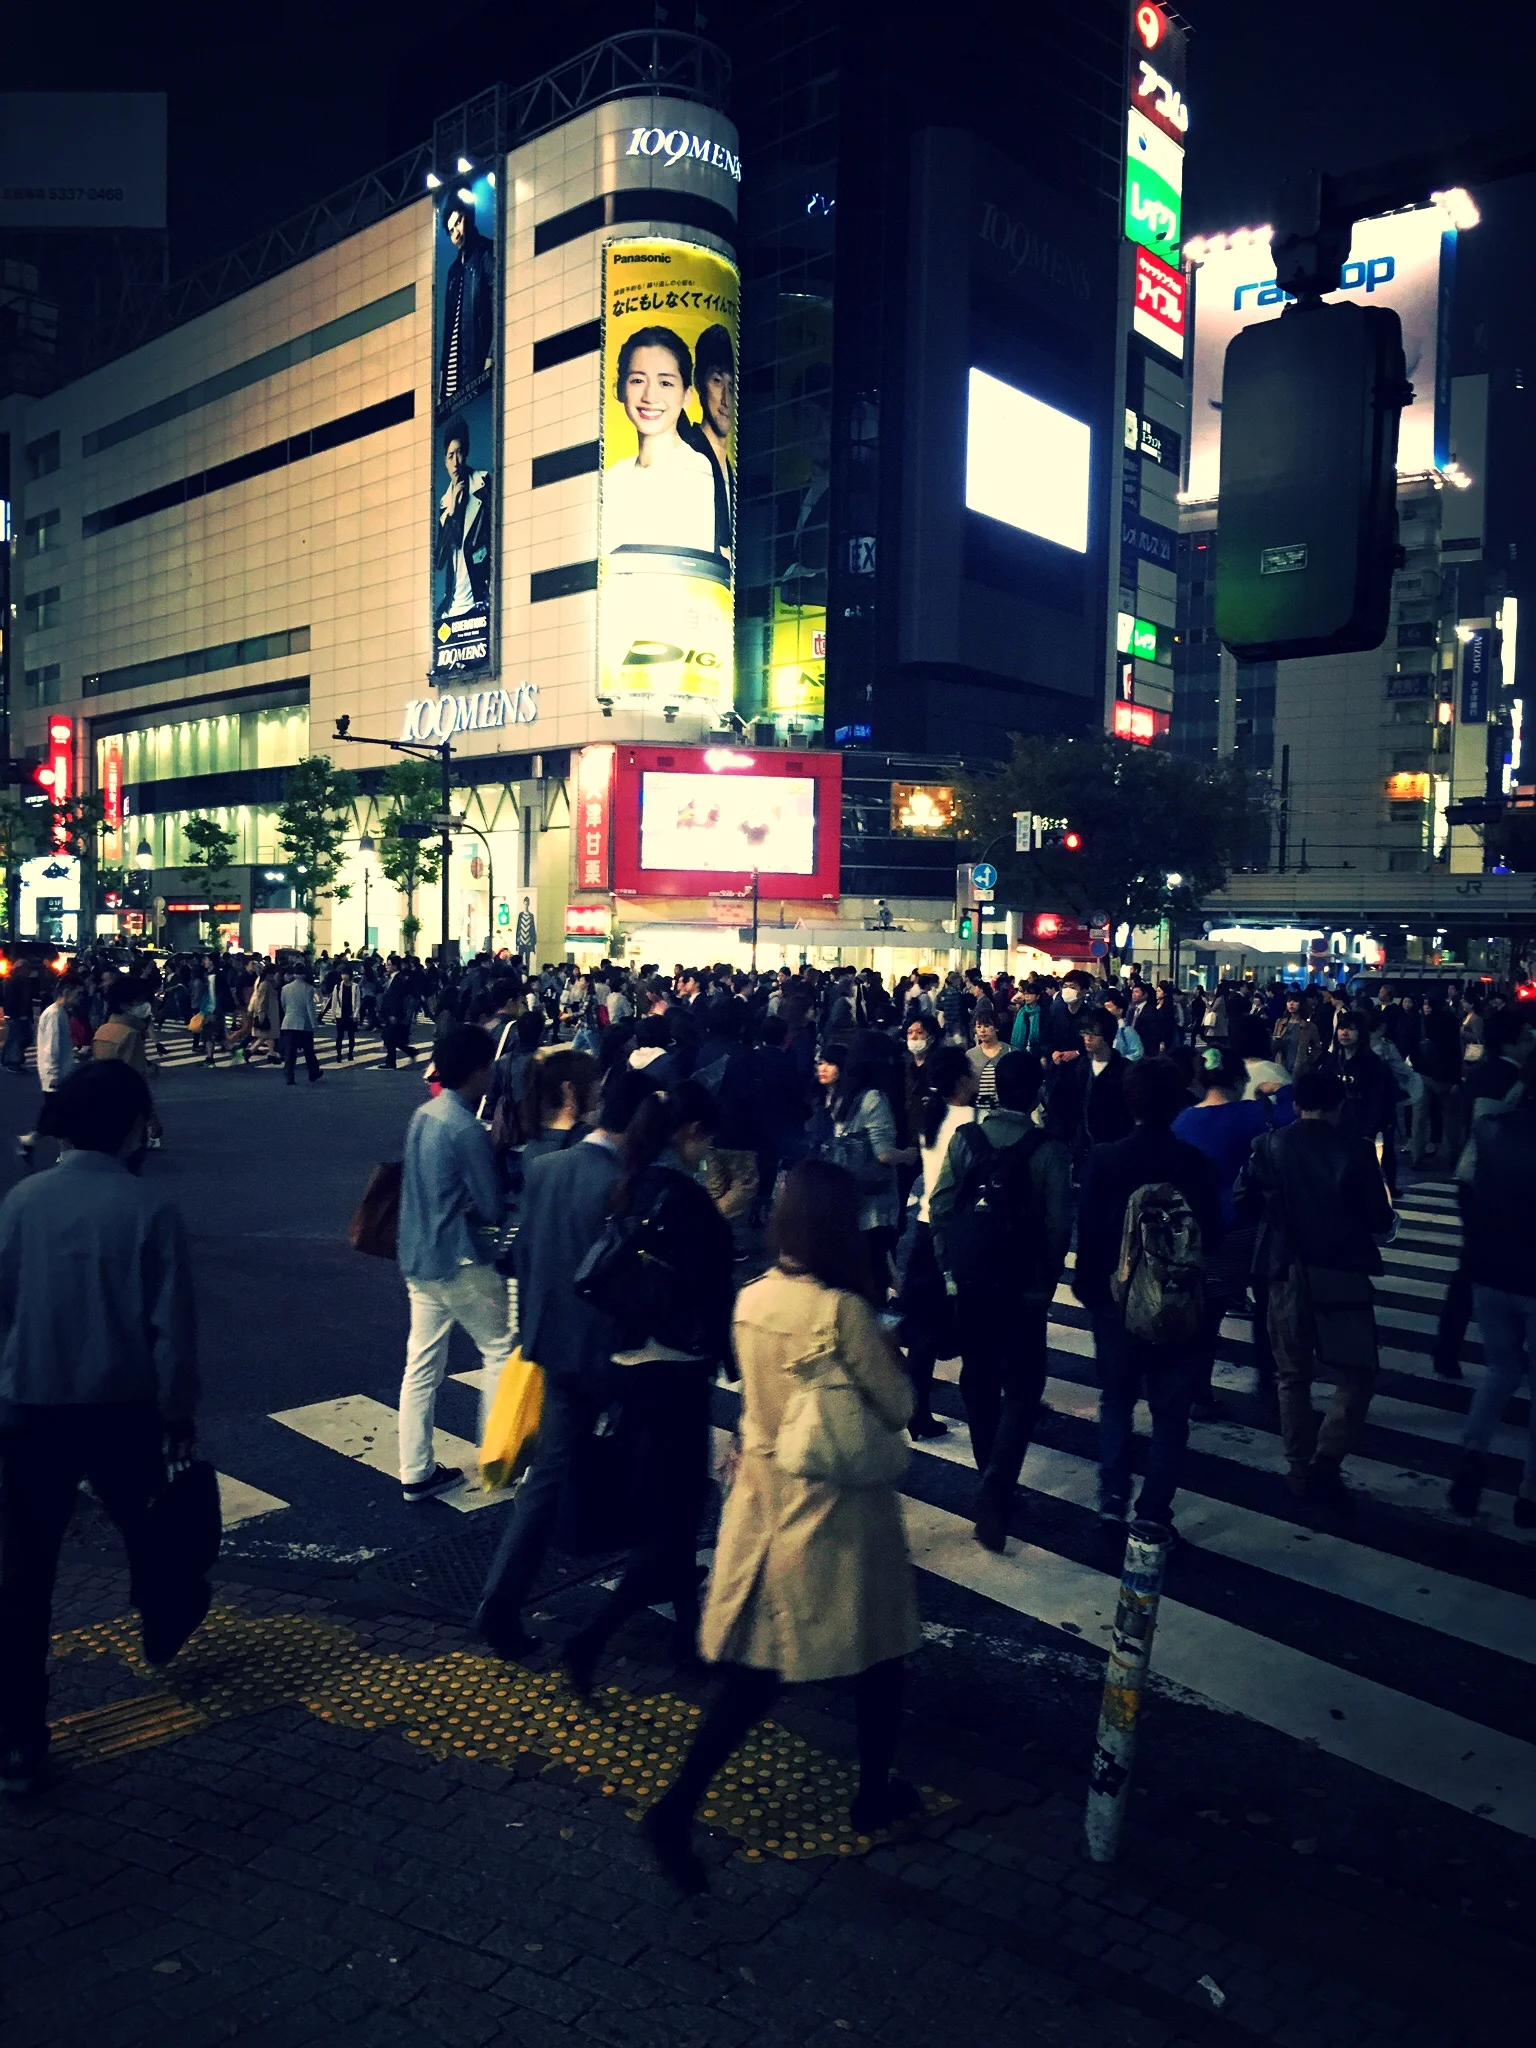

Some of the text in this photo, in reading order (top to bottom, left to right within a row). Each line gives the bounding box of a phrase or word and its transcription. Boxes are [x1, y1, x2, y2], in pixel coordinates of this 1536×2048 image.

[1138, 60, 1189, 132] アコム
[1131, 181, 1177, 241] レイク
[613, 253, 672, 264] Panasonic
[1233, 256, 1395, 311] raop
[1138, 273, 1183, 323] アイフル
[622, 640, 724, 669] DIG
[399, 680, 539, 746] 109MEN'S
[1456, 880, 1482, 894] JR
